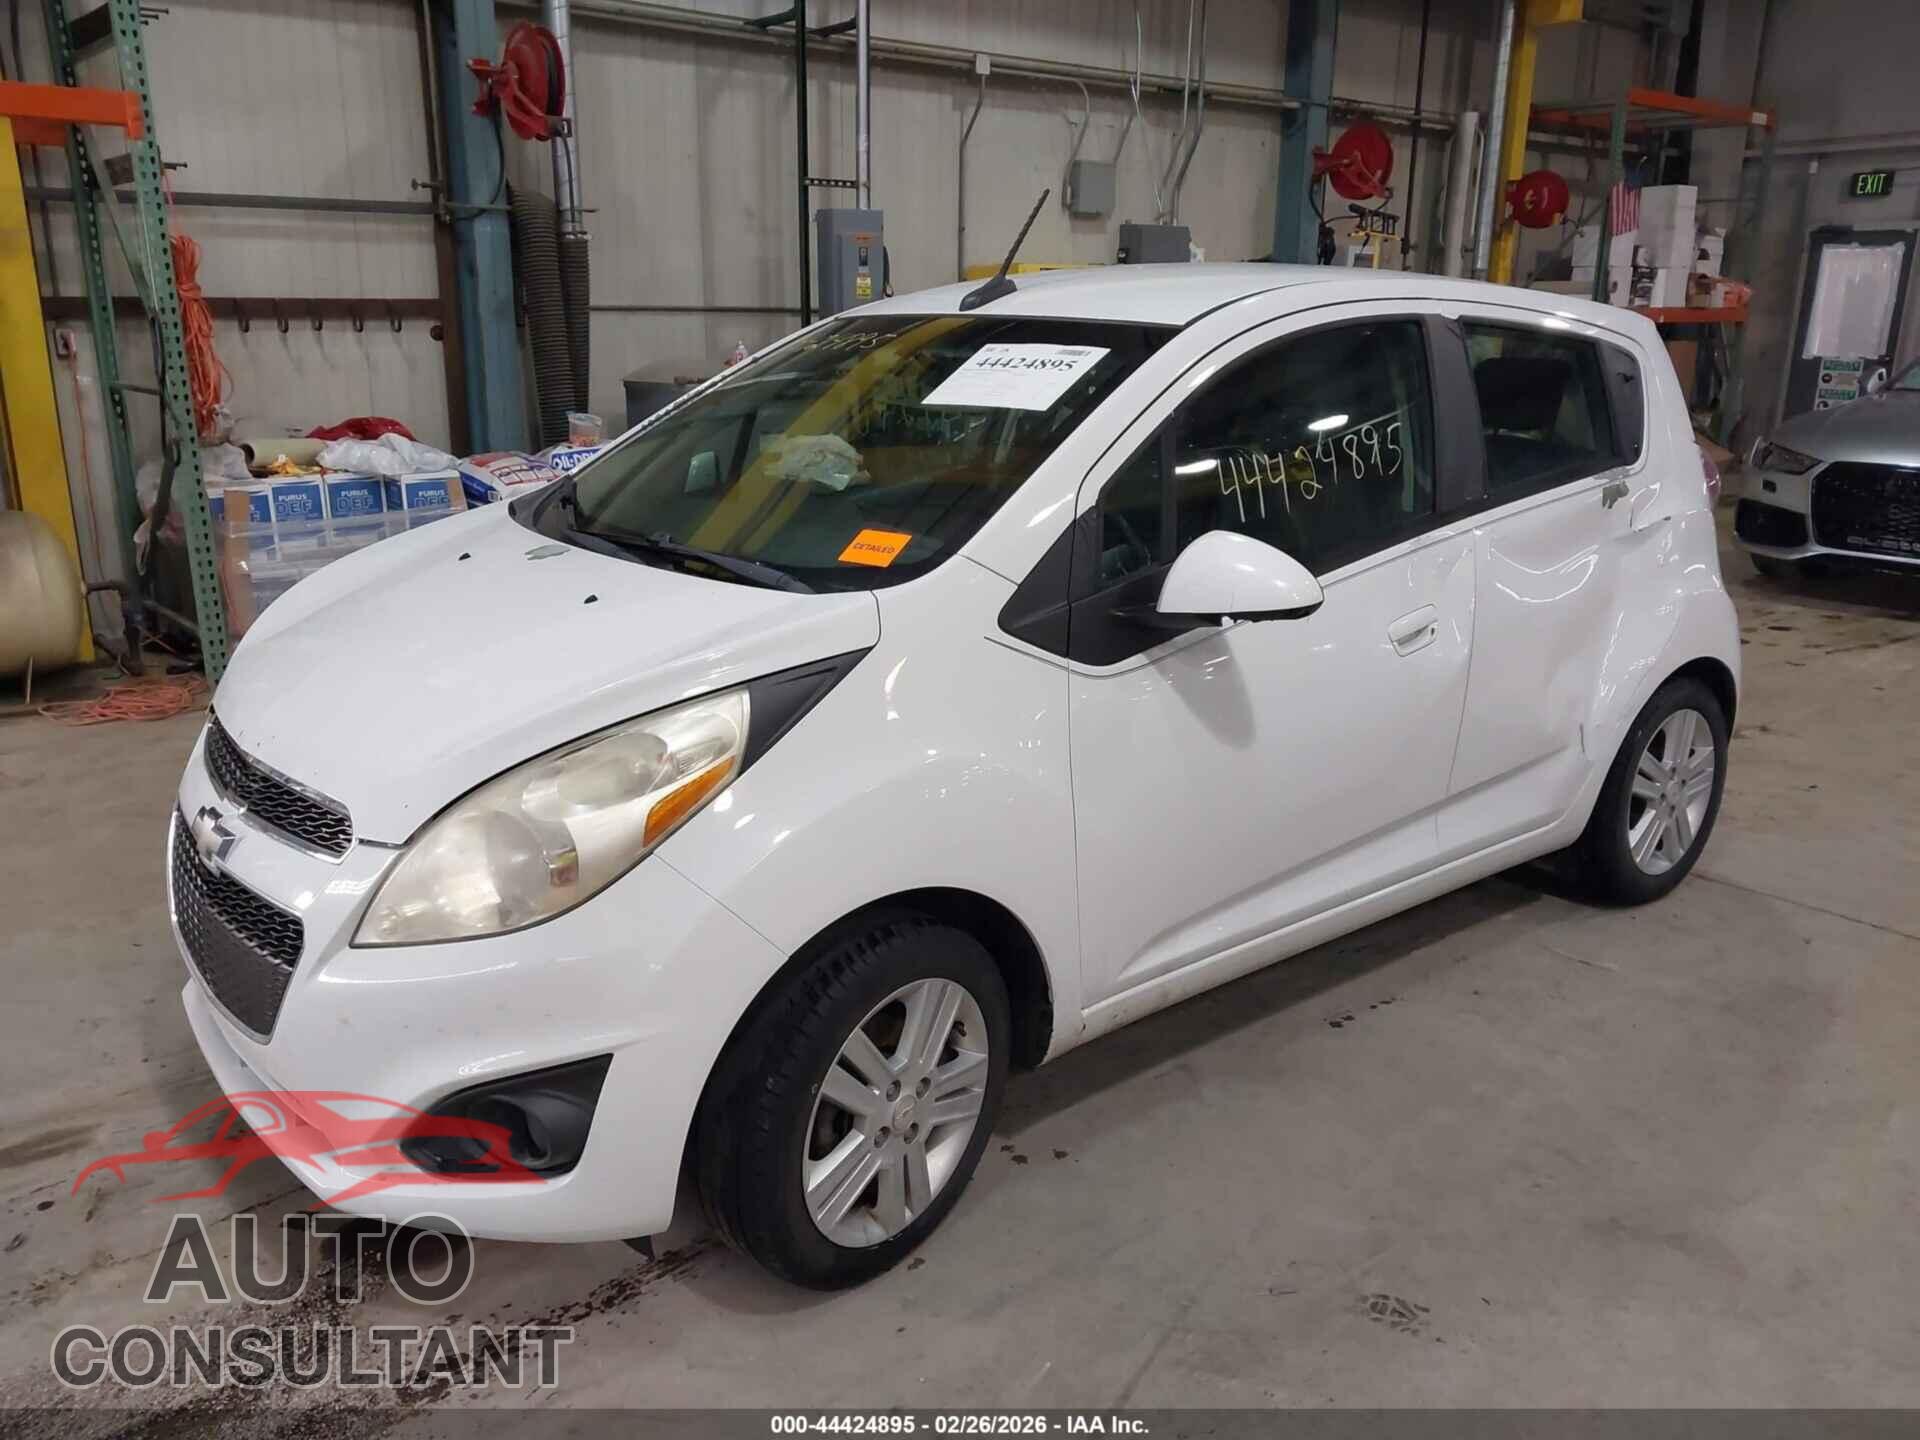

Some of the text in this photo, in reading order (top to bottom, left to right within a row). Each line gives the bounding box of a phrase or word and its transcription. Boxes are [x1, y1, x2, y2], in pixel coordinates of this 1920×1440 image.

[1856, 174, 1888, 194] EXIT
[976, 357, 1079, 371] 44424895
[1216, 422, 1401, 523] 44424895
[275, 500, 313, 515] DEF
